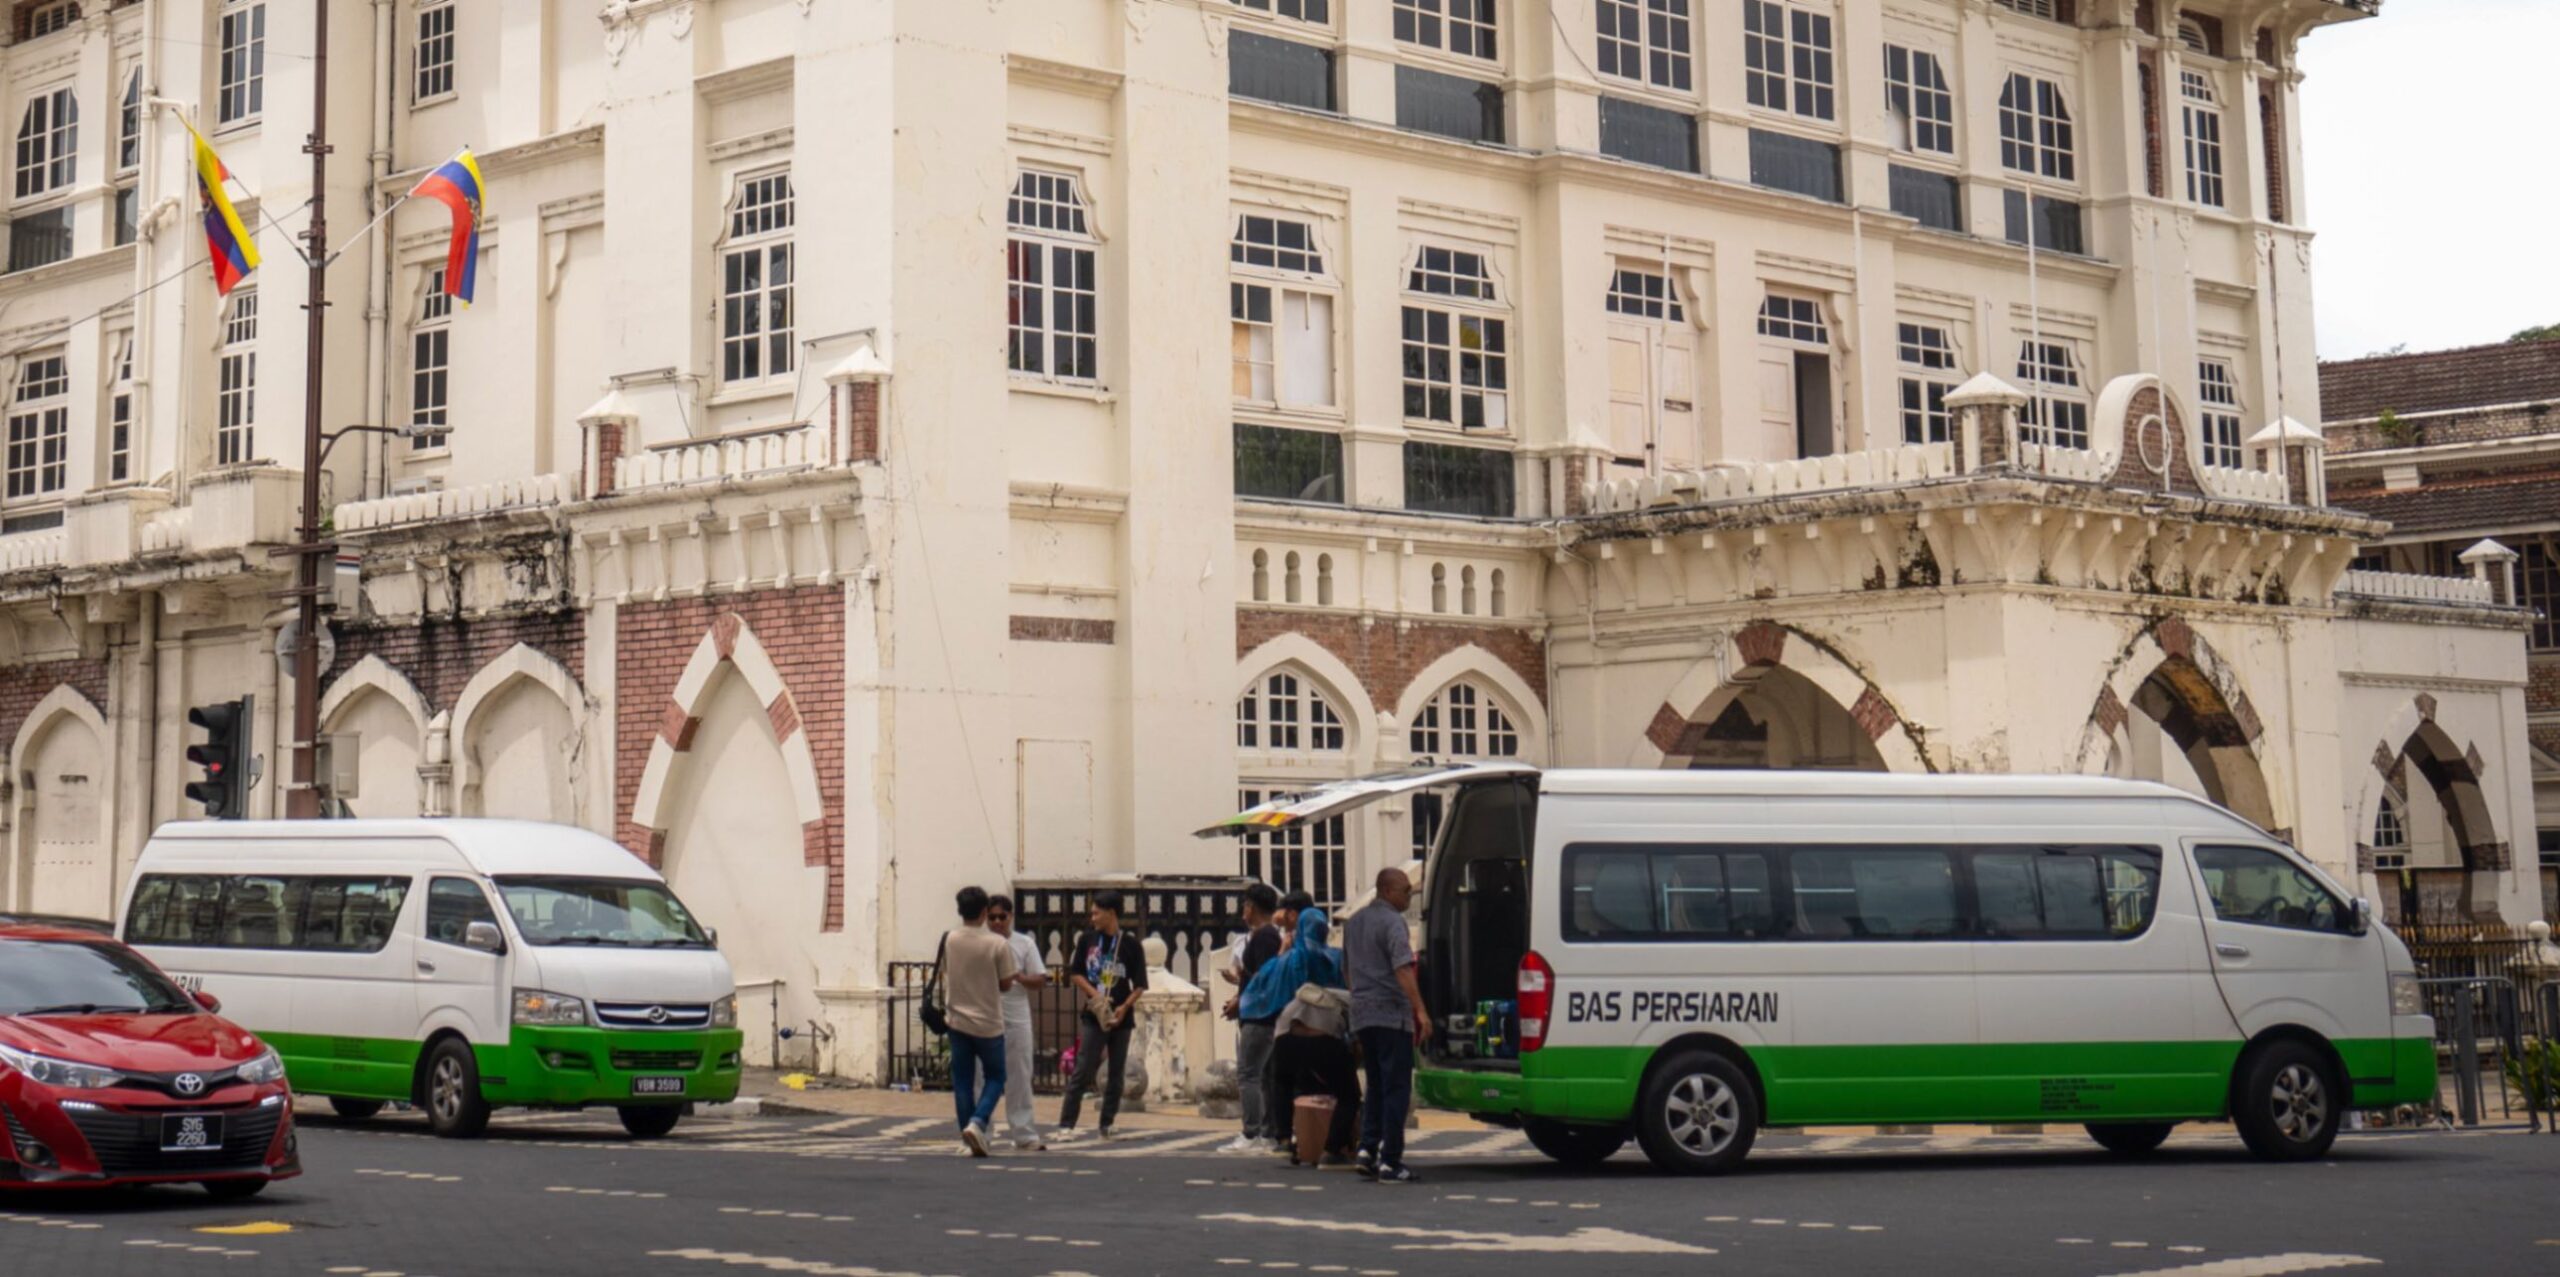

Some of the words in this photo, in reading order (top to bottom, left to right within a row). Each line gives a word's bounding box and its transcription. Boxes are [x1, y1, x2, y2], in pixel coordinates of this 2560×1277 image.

[1568, 991, 1622, 1022] BAS
[1632, 991, 1778, 1023] PERSIARAN
[182, 1117, 204, 1131] SYG
[176, 1131, 207, 1146] 2260
